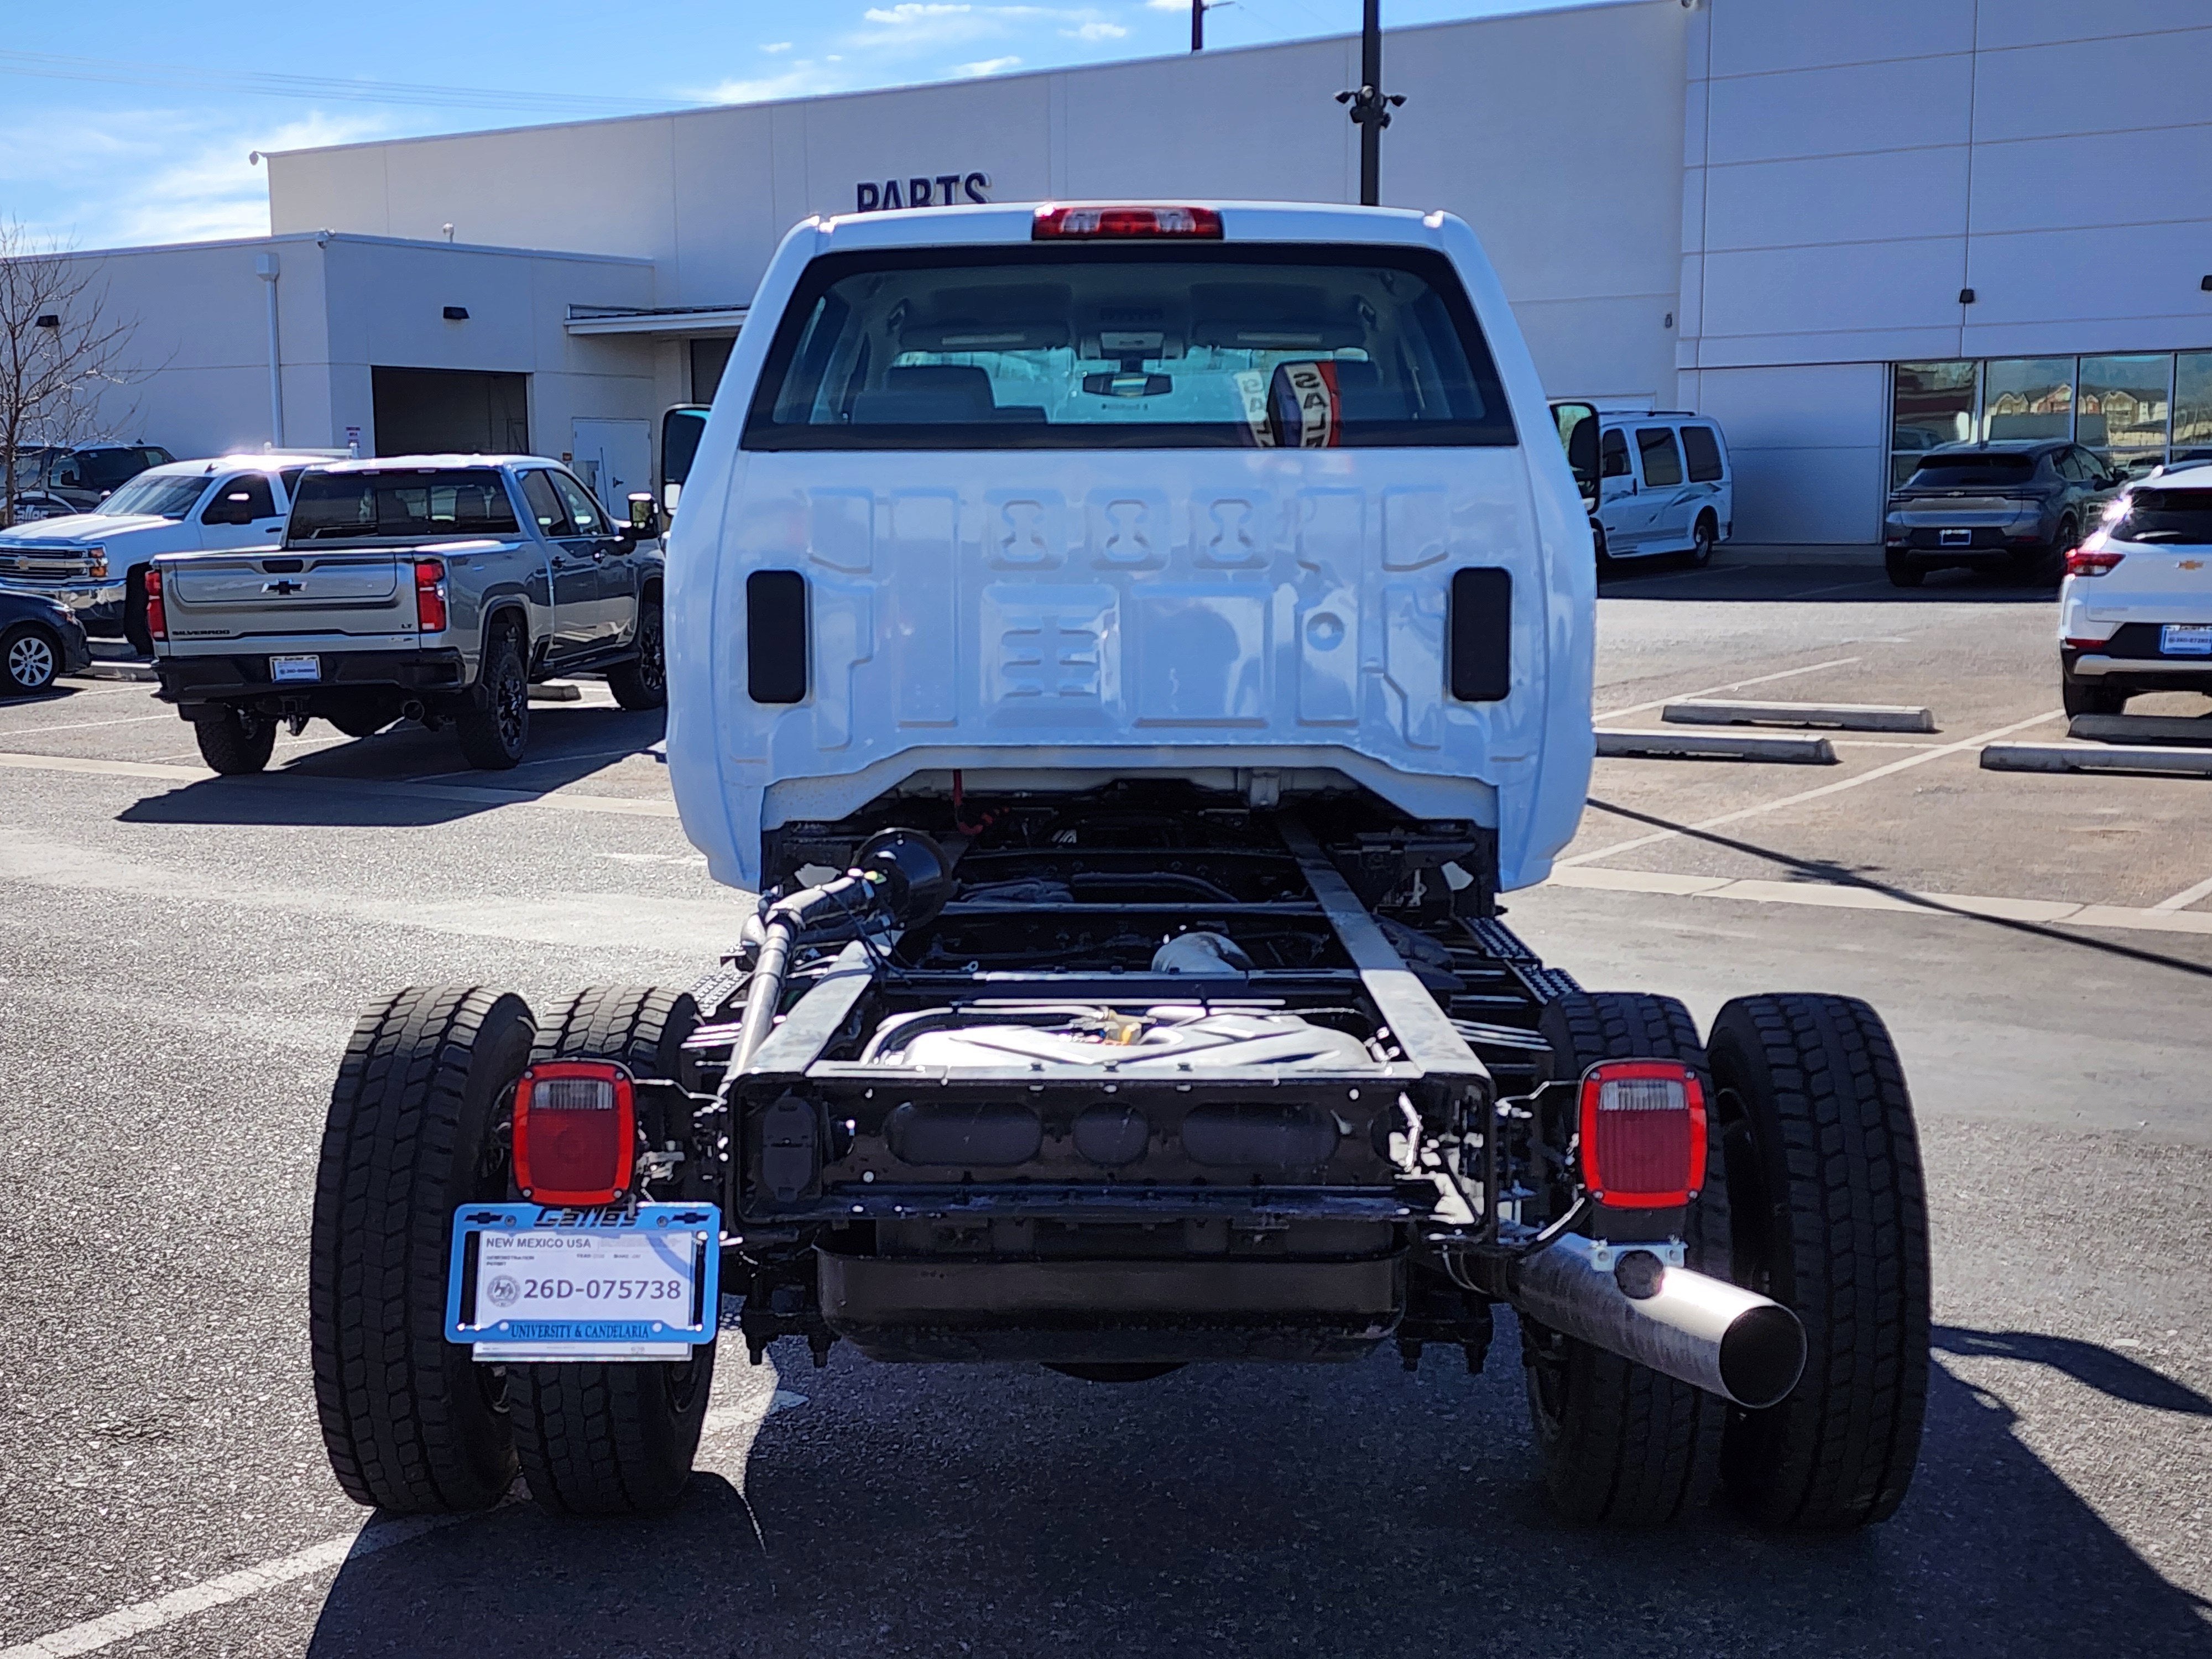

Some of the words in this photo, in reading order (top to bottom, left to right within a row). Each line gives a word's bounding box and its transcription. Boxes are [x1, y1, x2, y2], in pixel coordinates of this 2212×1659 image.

[857, 171, 990, 213] PARTS
[487, 1238, 514, 1248] NEW
[517, 1238, 564, 1248] MEXICO
[567, 1238, 592, 1249] USA
[523, 1279, 682, 1300] 26D-075738
[511, 1324, 571, 1338] UNIVERSITY
[575, 1324, 583, 1338] &
[585, 1324, 649, 1339] CANDELARIA
